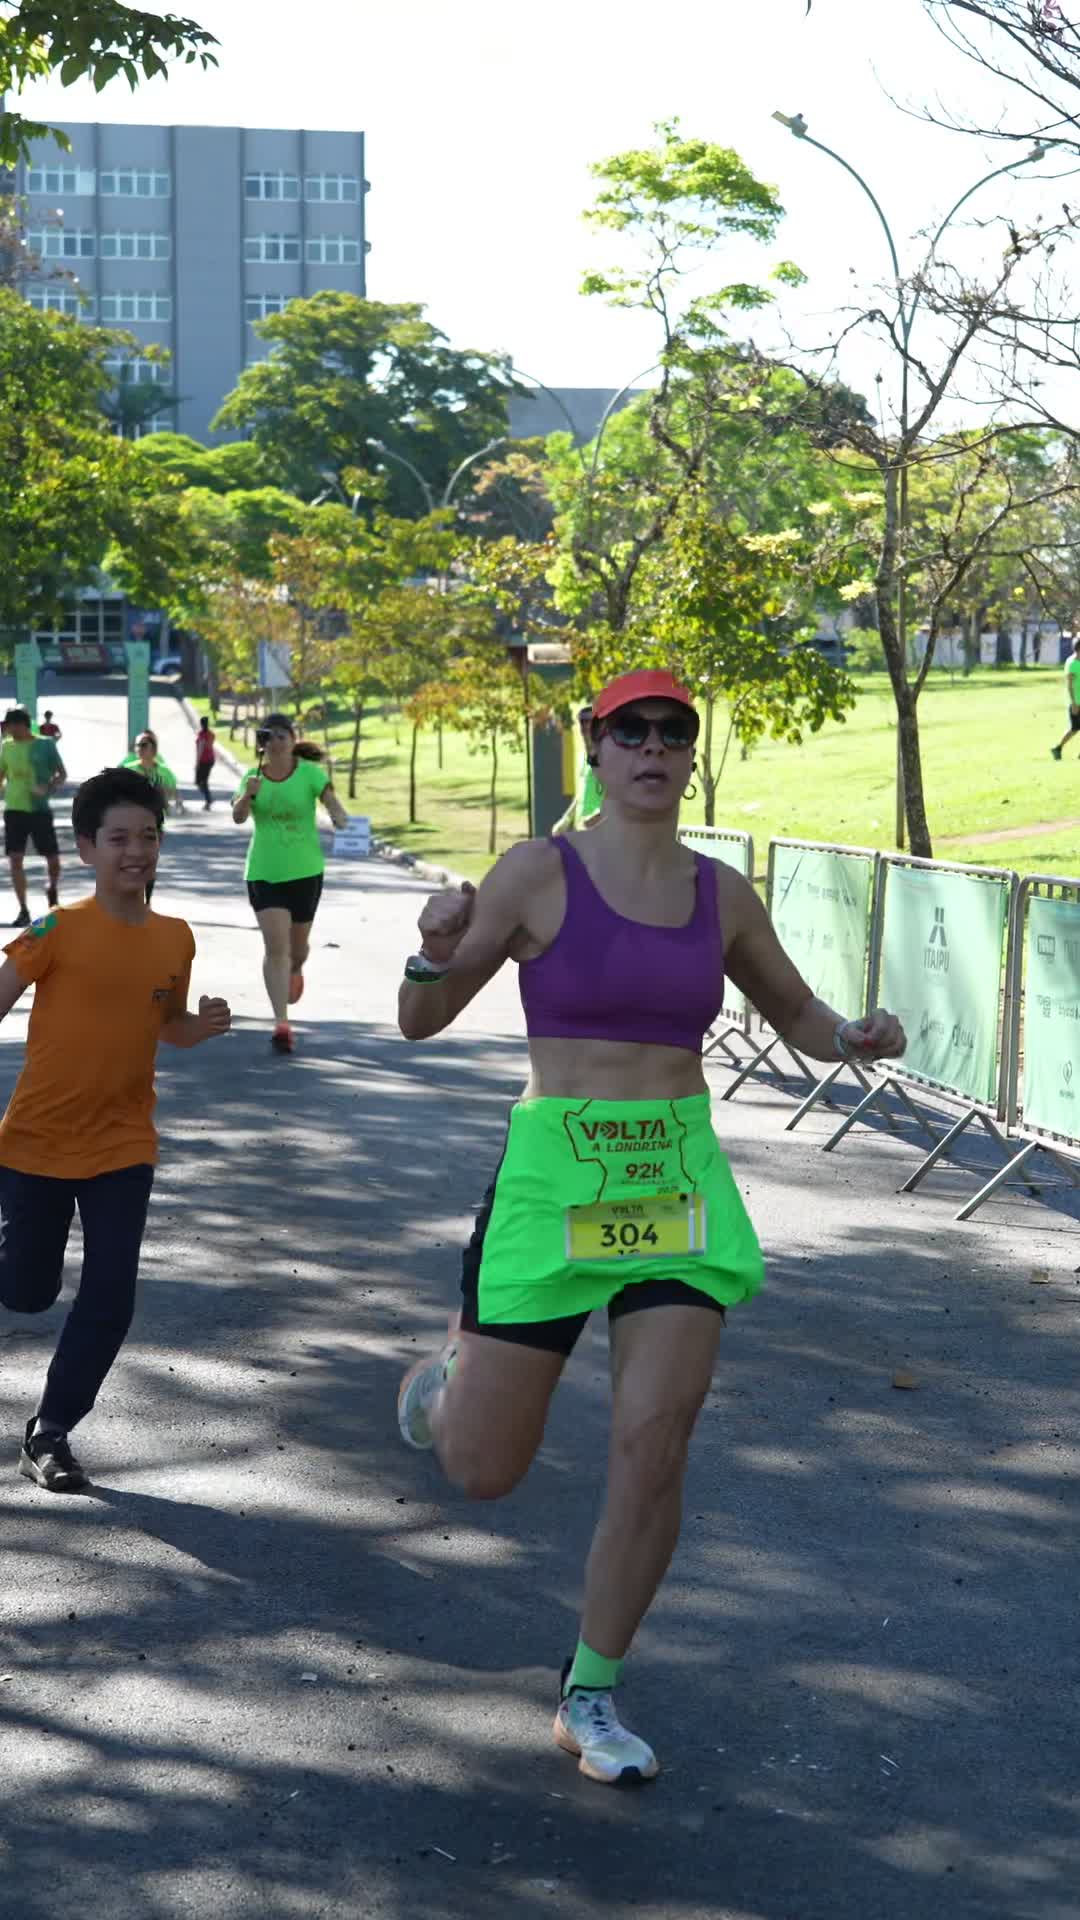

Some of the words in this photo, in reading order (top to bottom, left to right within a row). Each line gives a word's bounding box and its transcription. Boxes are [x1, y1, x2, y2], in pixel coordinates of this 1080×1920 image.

[923, 948, 950, 972] ITAIPU
[580, 1119, 665, 1140] VOLTA
[607, 1140, 672, 1153] LONDRINA
[626, 1163, 664, 1178] 92K
[600, 1223, 658, 1247] 304
